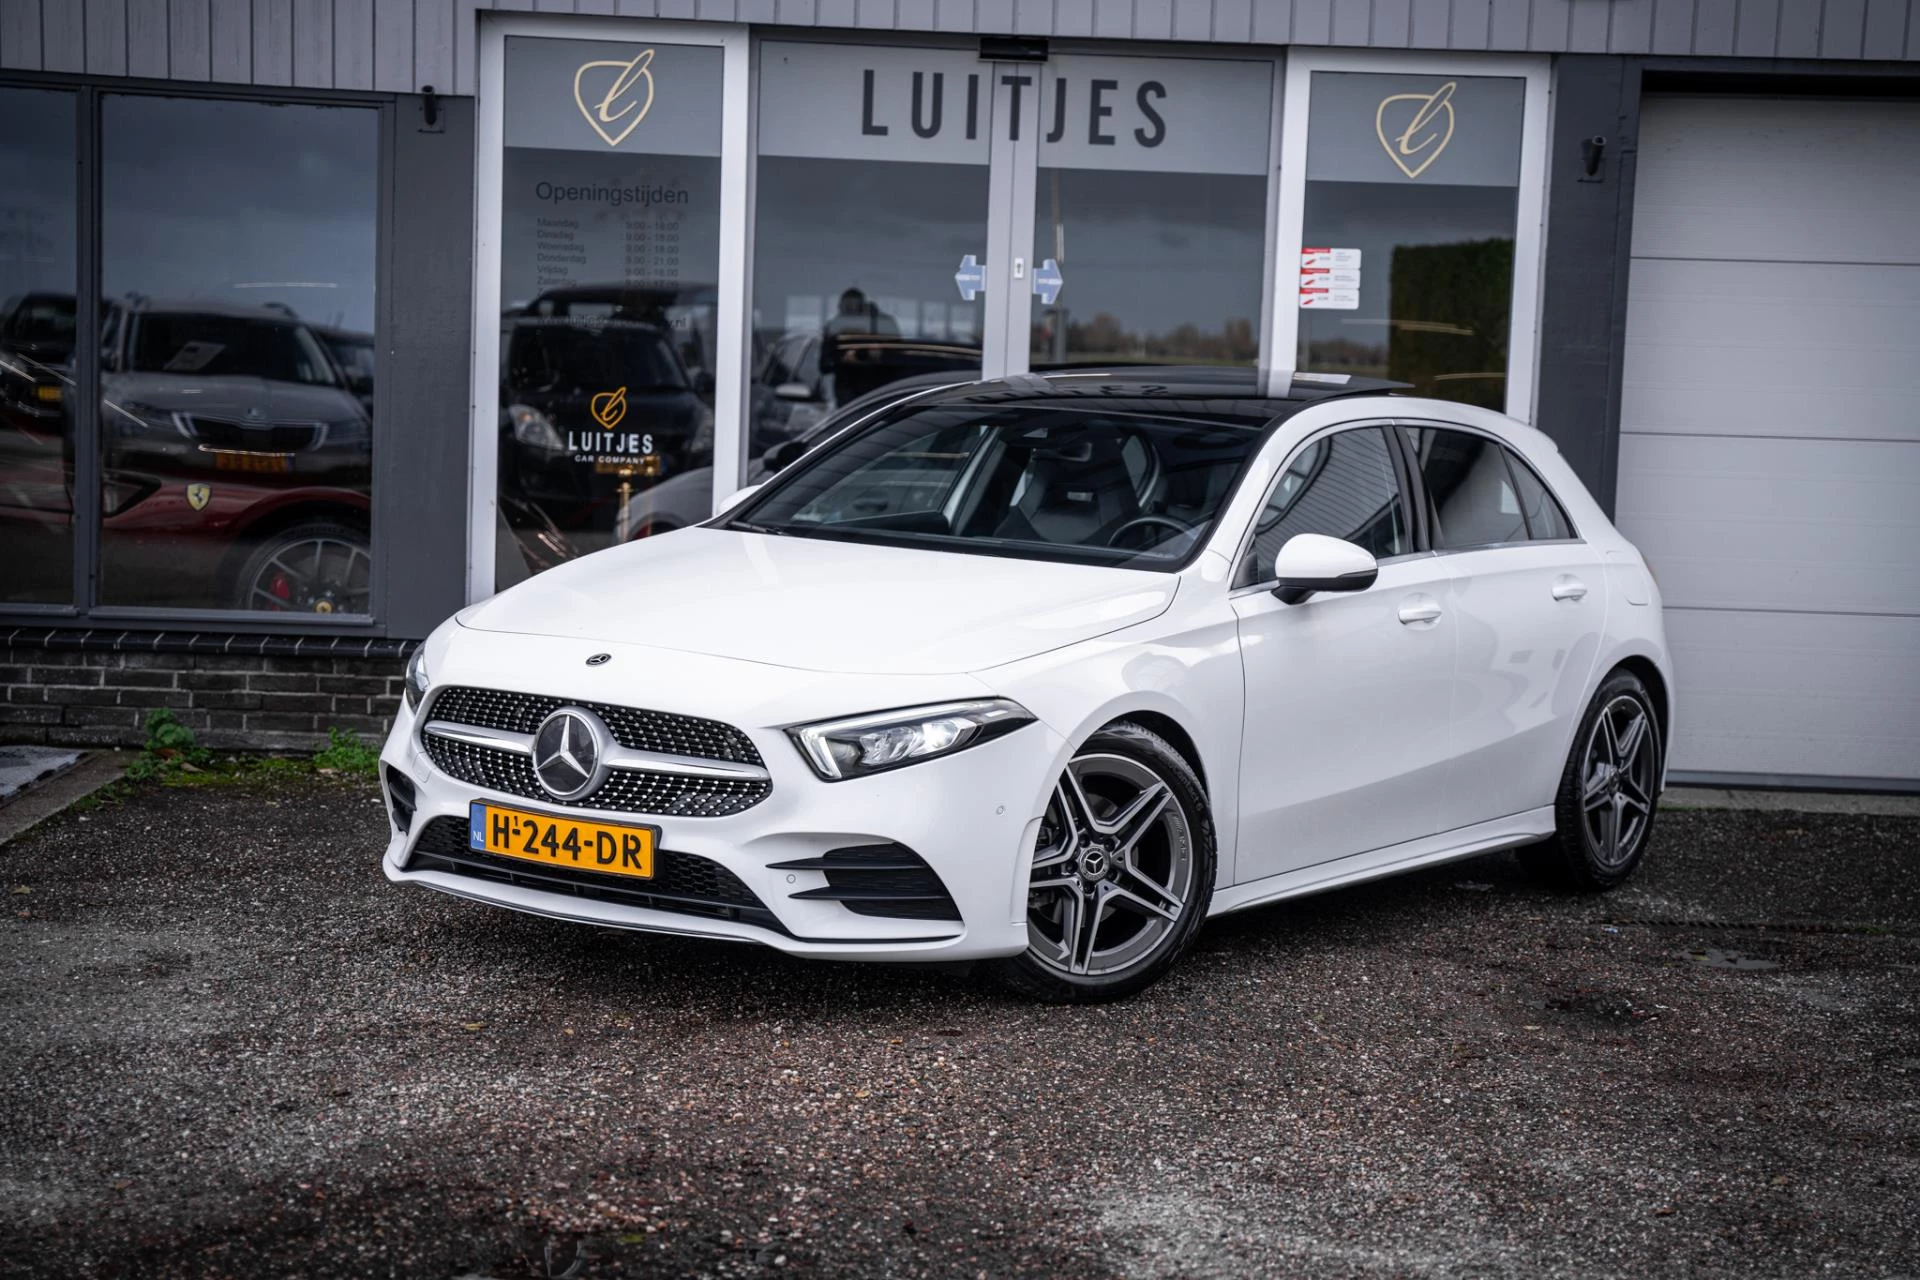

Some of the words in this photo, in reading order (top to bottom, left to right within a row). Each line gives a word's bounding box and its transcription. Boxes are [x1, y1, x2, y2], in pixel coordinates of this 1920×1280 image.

[862, 69, 1167, 148] LUITJES
[535, 181, 689, 207] Openingstijden
[568, 431, 653, 454] LUITJES
[575, 455, 594, 463] CAR
[598, 456, 645, 465] COMPANY
[473, 830, 484, 842] NL
